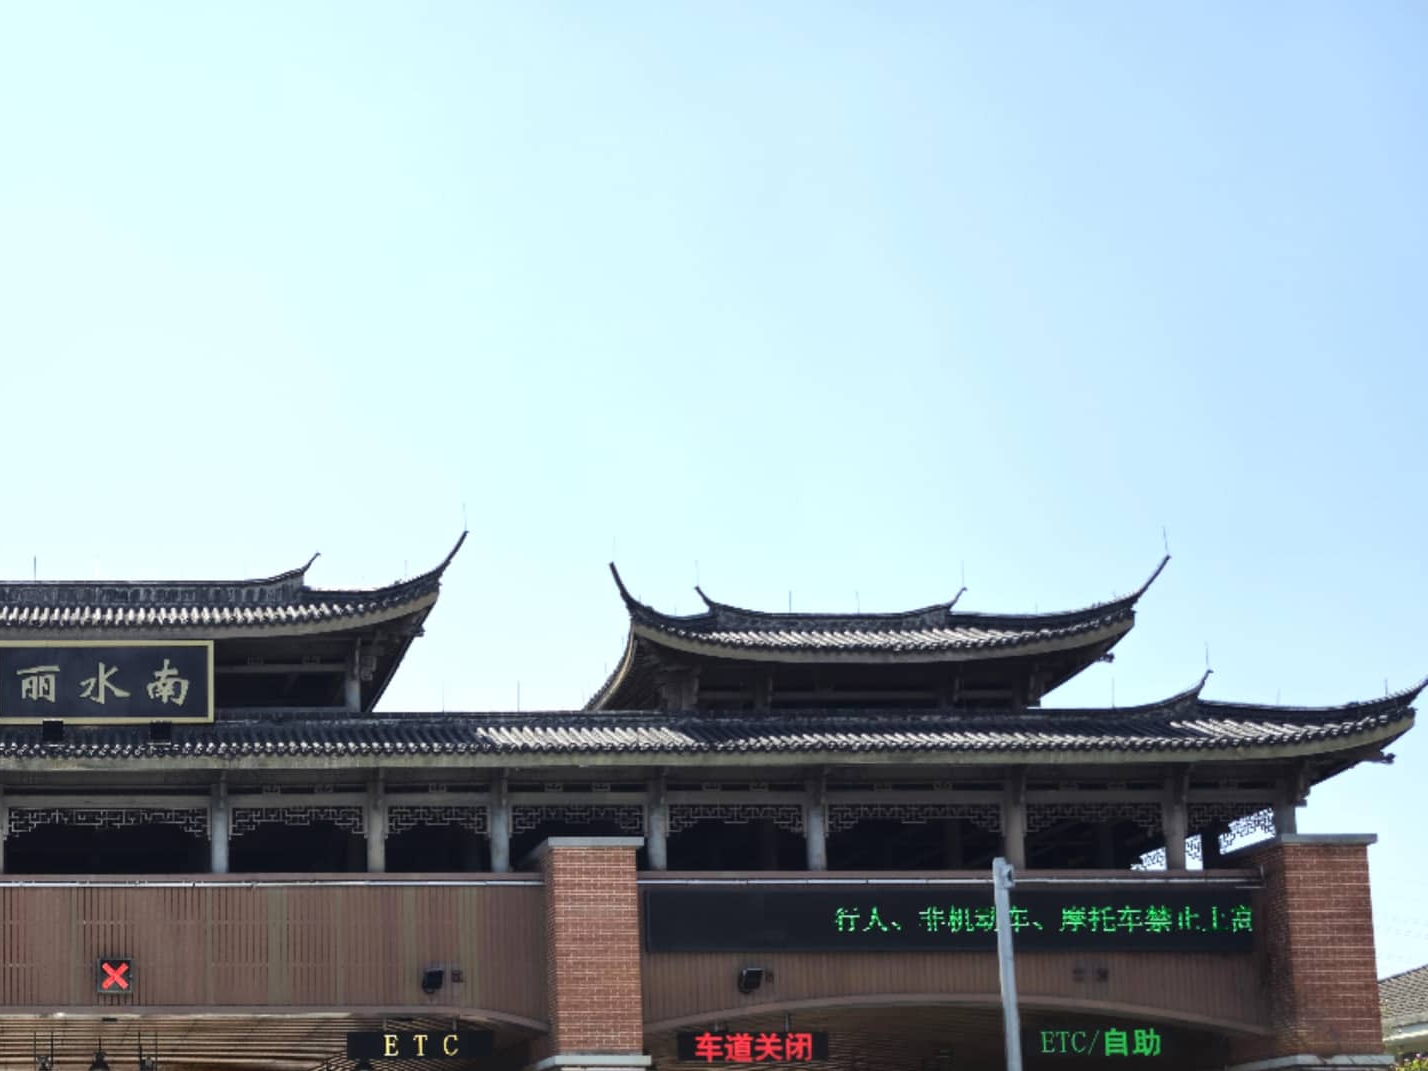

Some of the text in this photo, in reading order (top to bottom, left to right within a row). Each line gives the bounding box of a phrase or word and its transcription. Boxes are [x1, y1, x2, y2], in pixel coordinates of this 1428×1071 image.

[16, 658, 190, 707] 丽水南
[383, 1034, 459, 1057] ETC
[694, 1031, 813, 1064] 车道关闭
[1040, 1027, 1162, 1057] ETC/自助
